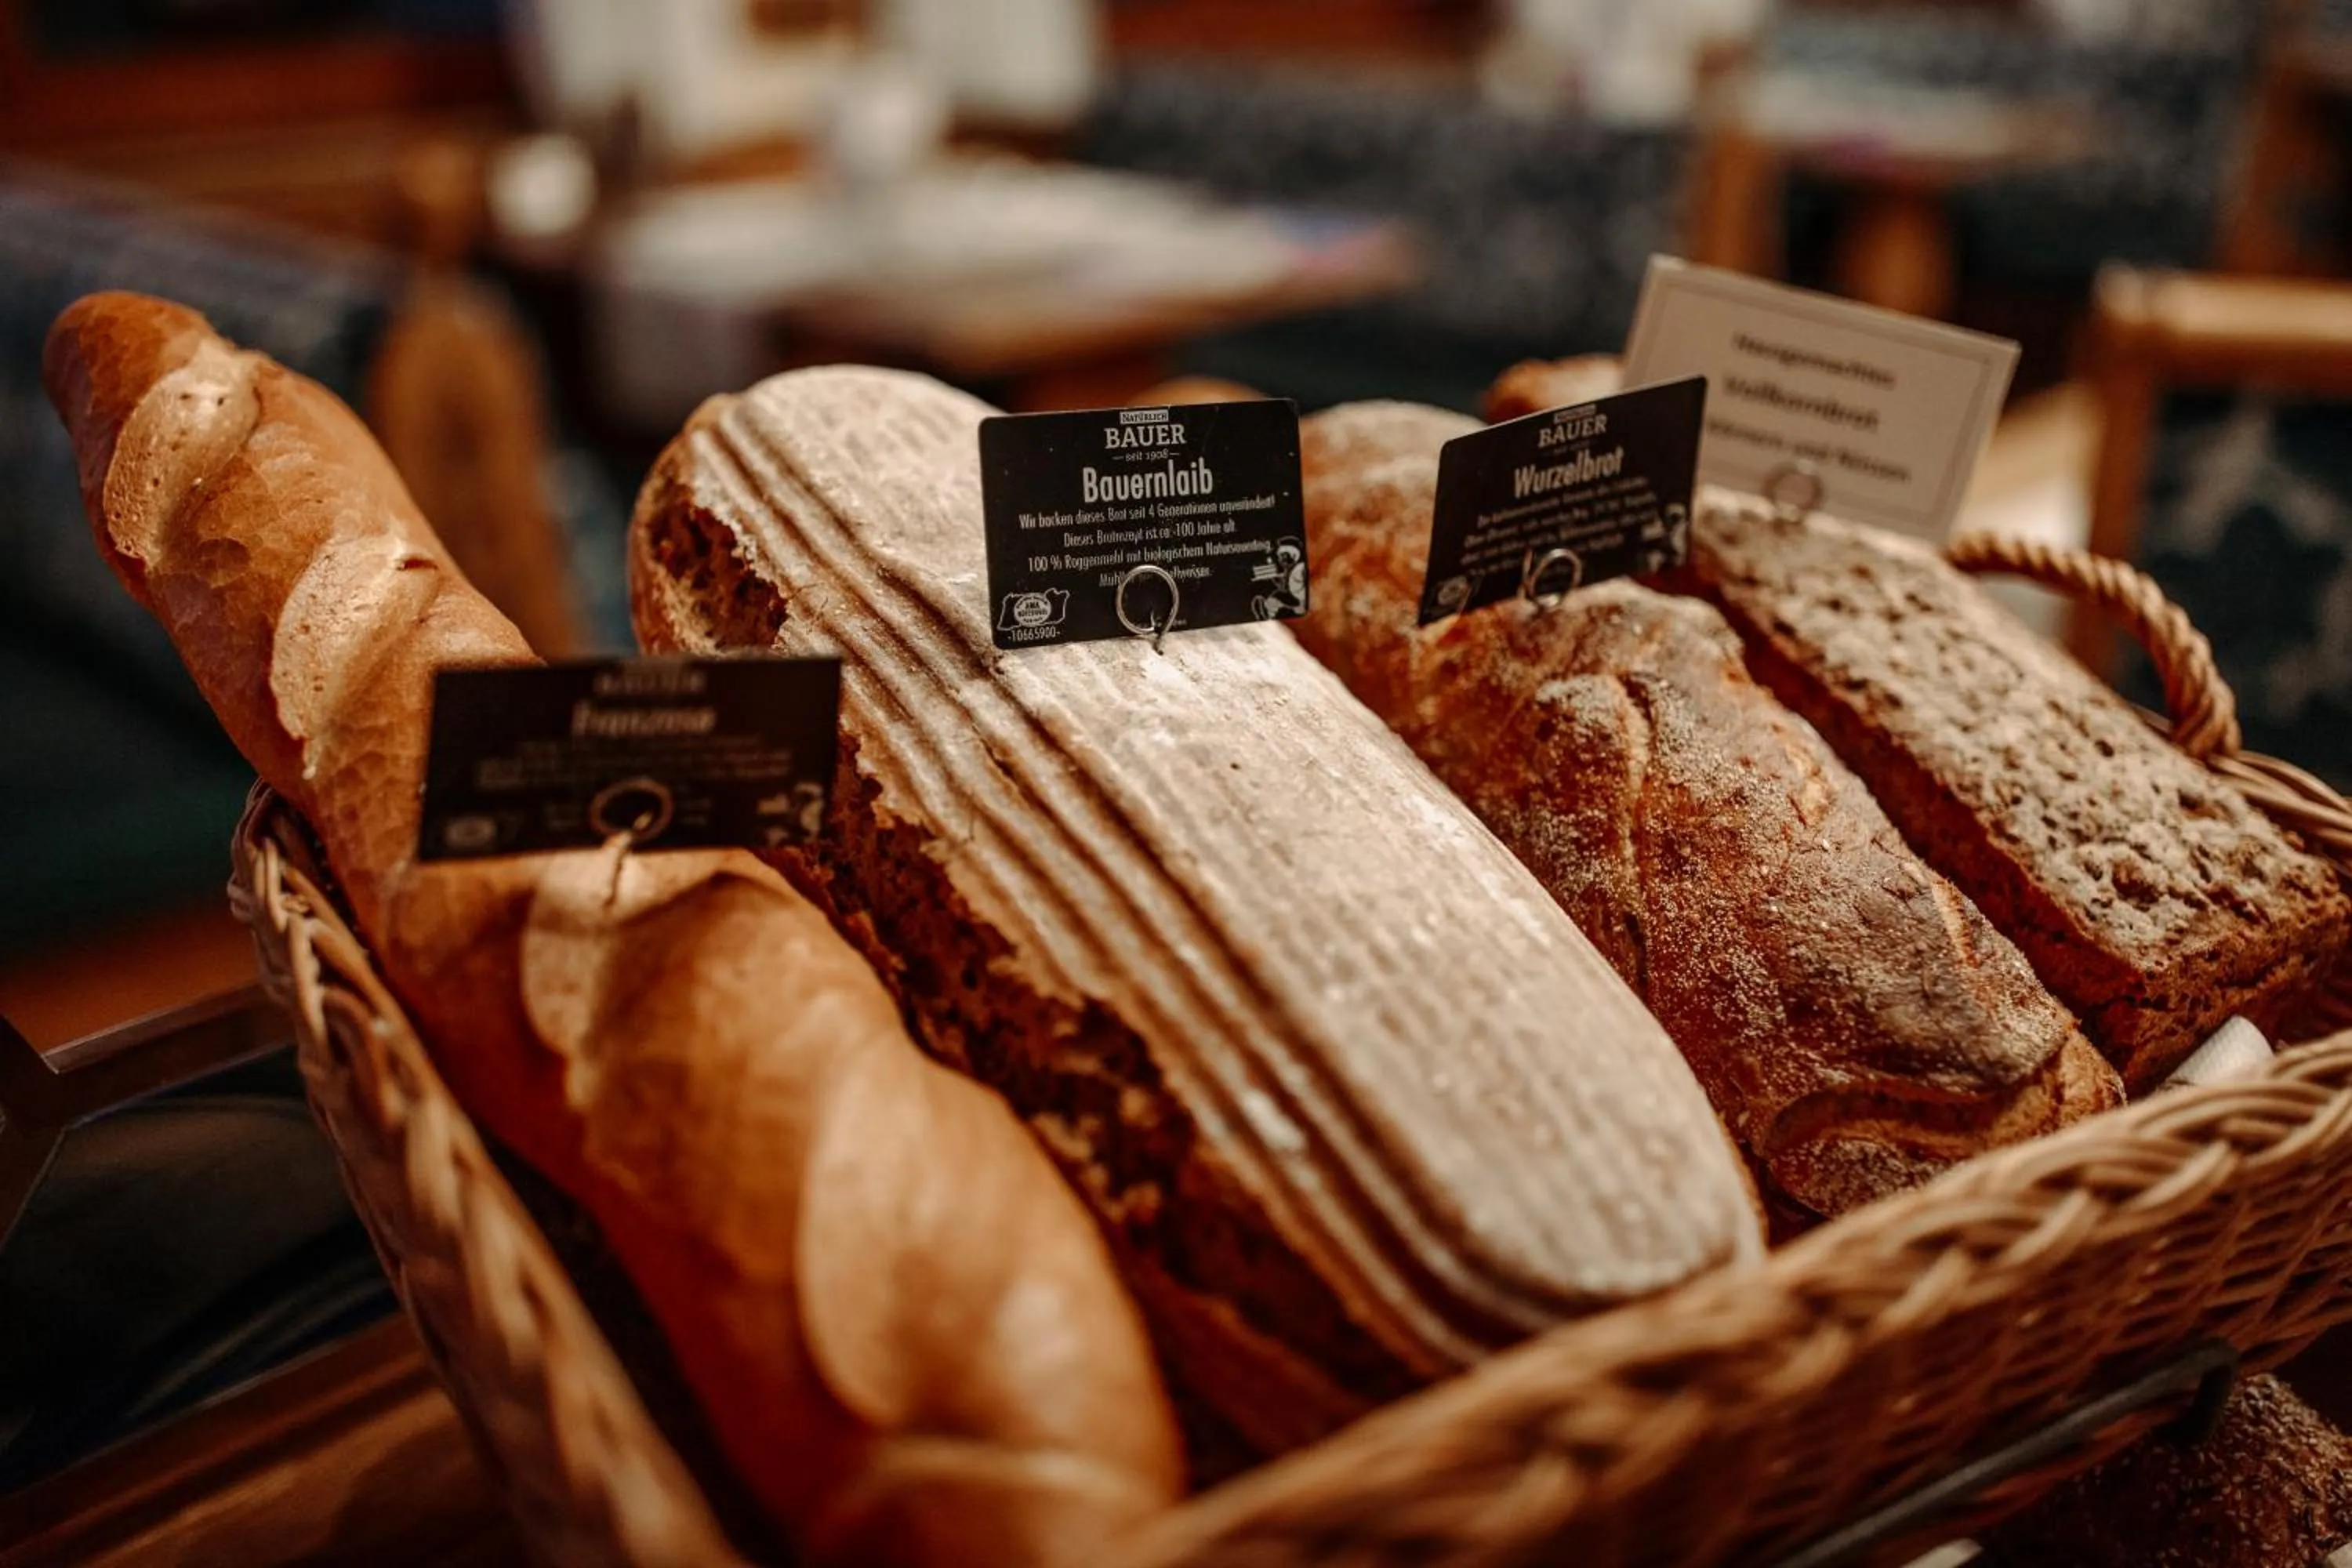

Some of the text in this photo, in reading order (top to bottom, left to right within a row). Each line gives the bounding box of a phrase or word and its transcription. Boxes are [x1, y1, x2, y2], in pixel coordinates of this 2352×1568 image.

[1104, 423, 1188, 449] BAUER
[1538, 414, 1607, 448] BAUER
[1083, 456, 1213, 503] Bauernlaib
[1515, 445, 1624, 499] Wurzelbrot
[1018, 513, 1036, 529] Wir
[1038, 511, 1073, 528] backen
[1075, 509, 1105, 524] dieses
[1107, 506, 1127, 521] Brot
[1129, 505, 1146, 520] seit
[1148, 503, 1155, 518] 4
[1157, 500, 1218, 518] Generationen
[1064, 532, 1094, 548] Dieses
[1028, 555, 1048, 572] 100
[1064, 548, 1123, 572] Roggenmehl
[1126, 549, 1142, 563] mit
[1144, 543, 1204, 563] biologischem
